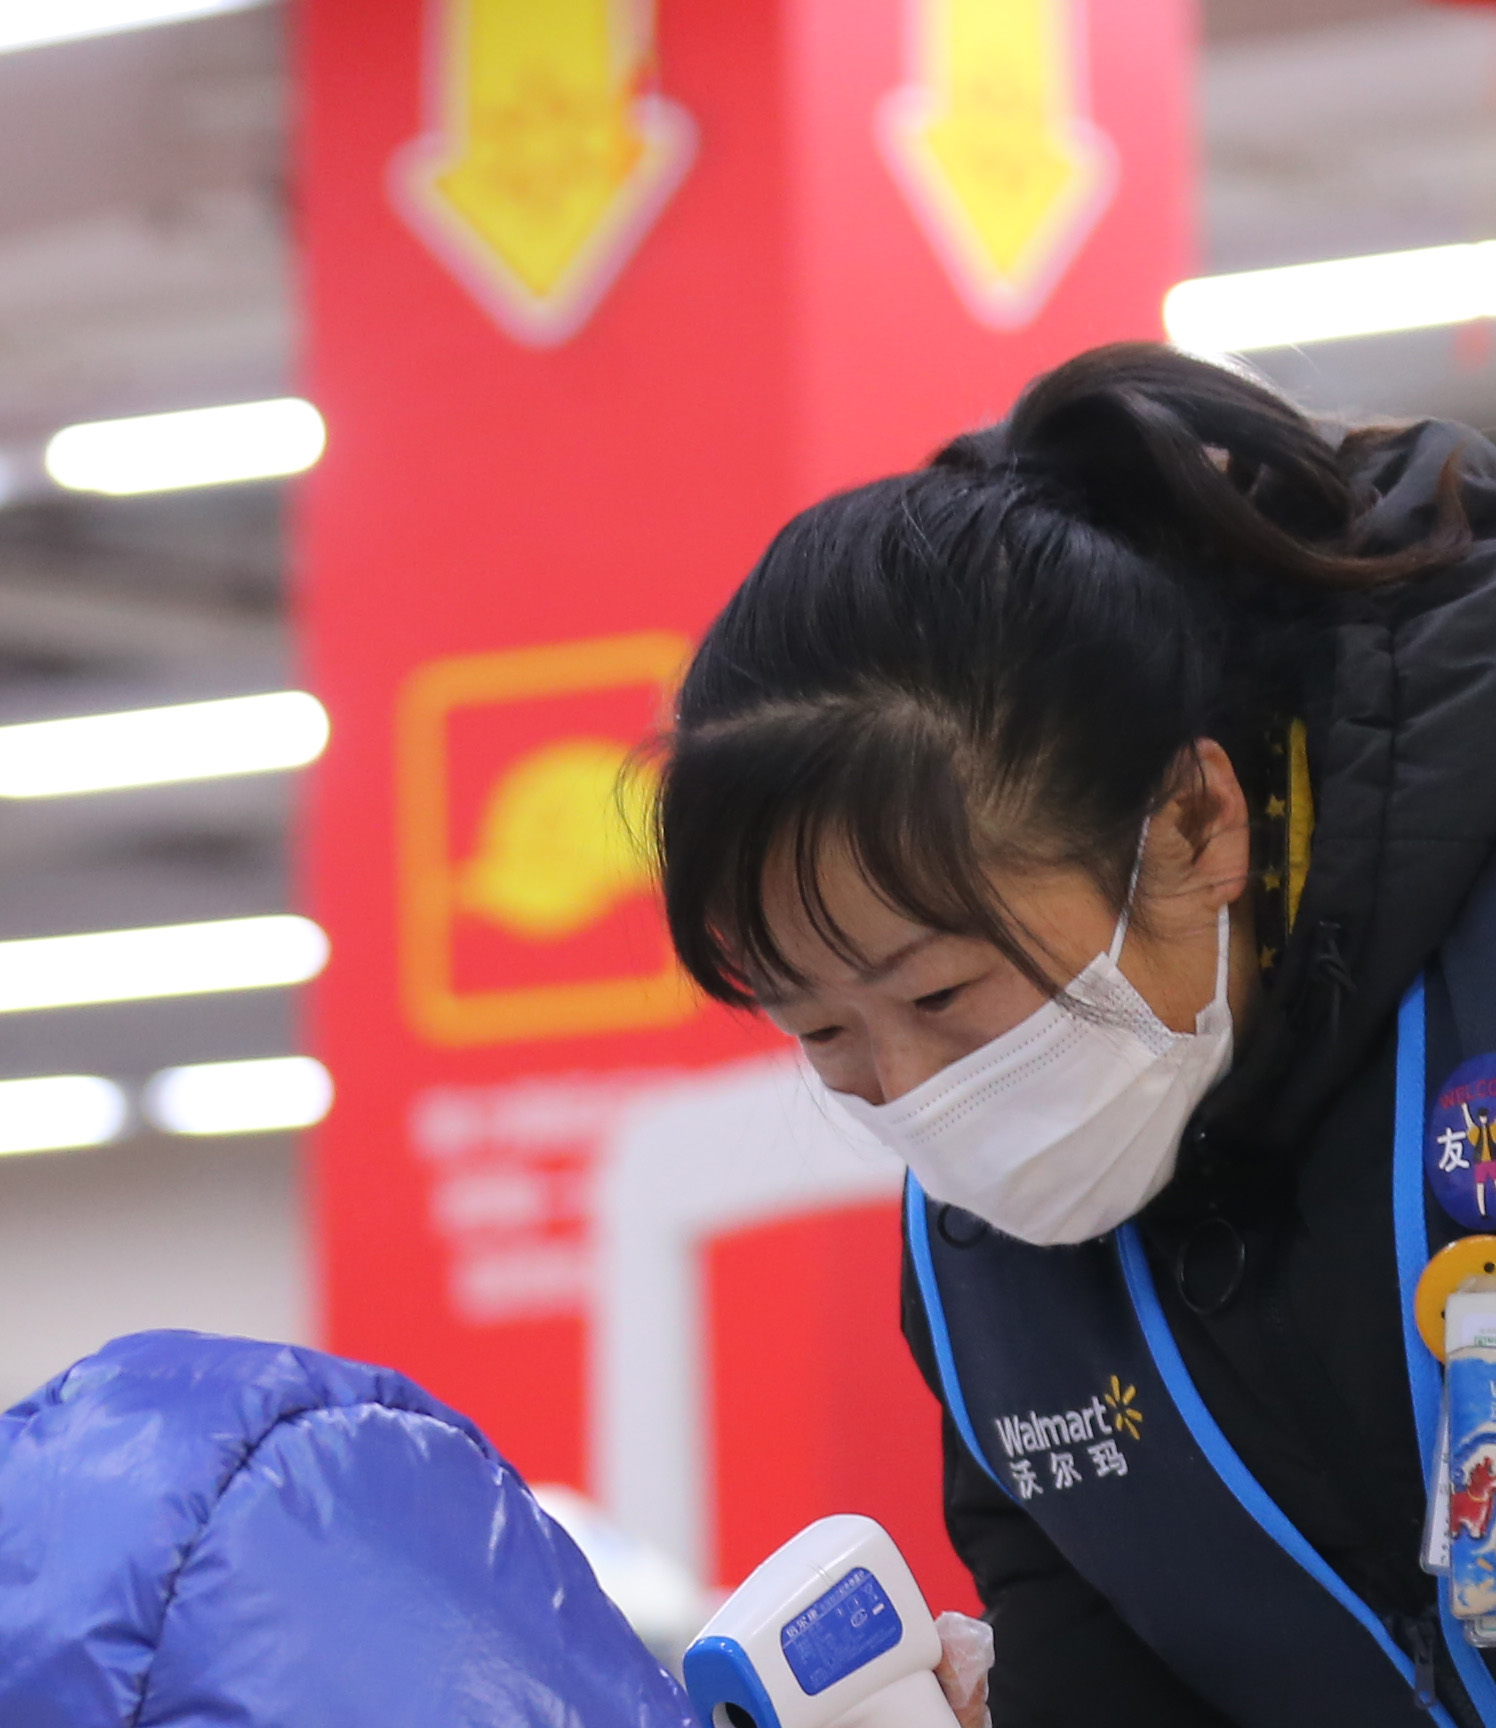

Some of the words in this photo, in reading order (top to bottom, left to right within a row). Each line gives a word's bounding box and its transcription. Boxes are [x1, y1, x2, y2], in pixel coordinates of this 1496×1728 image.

[995, 1395, 1113, 1458] Walmart
[1009, 1438, 1129, 1499] 沃尔玛
